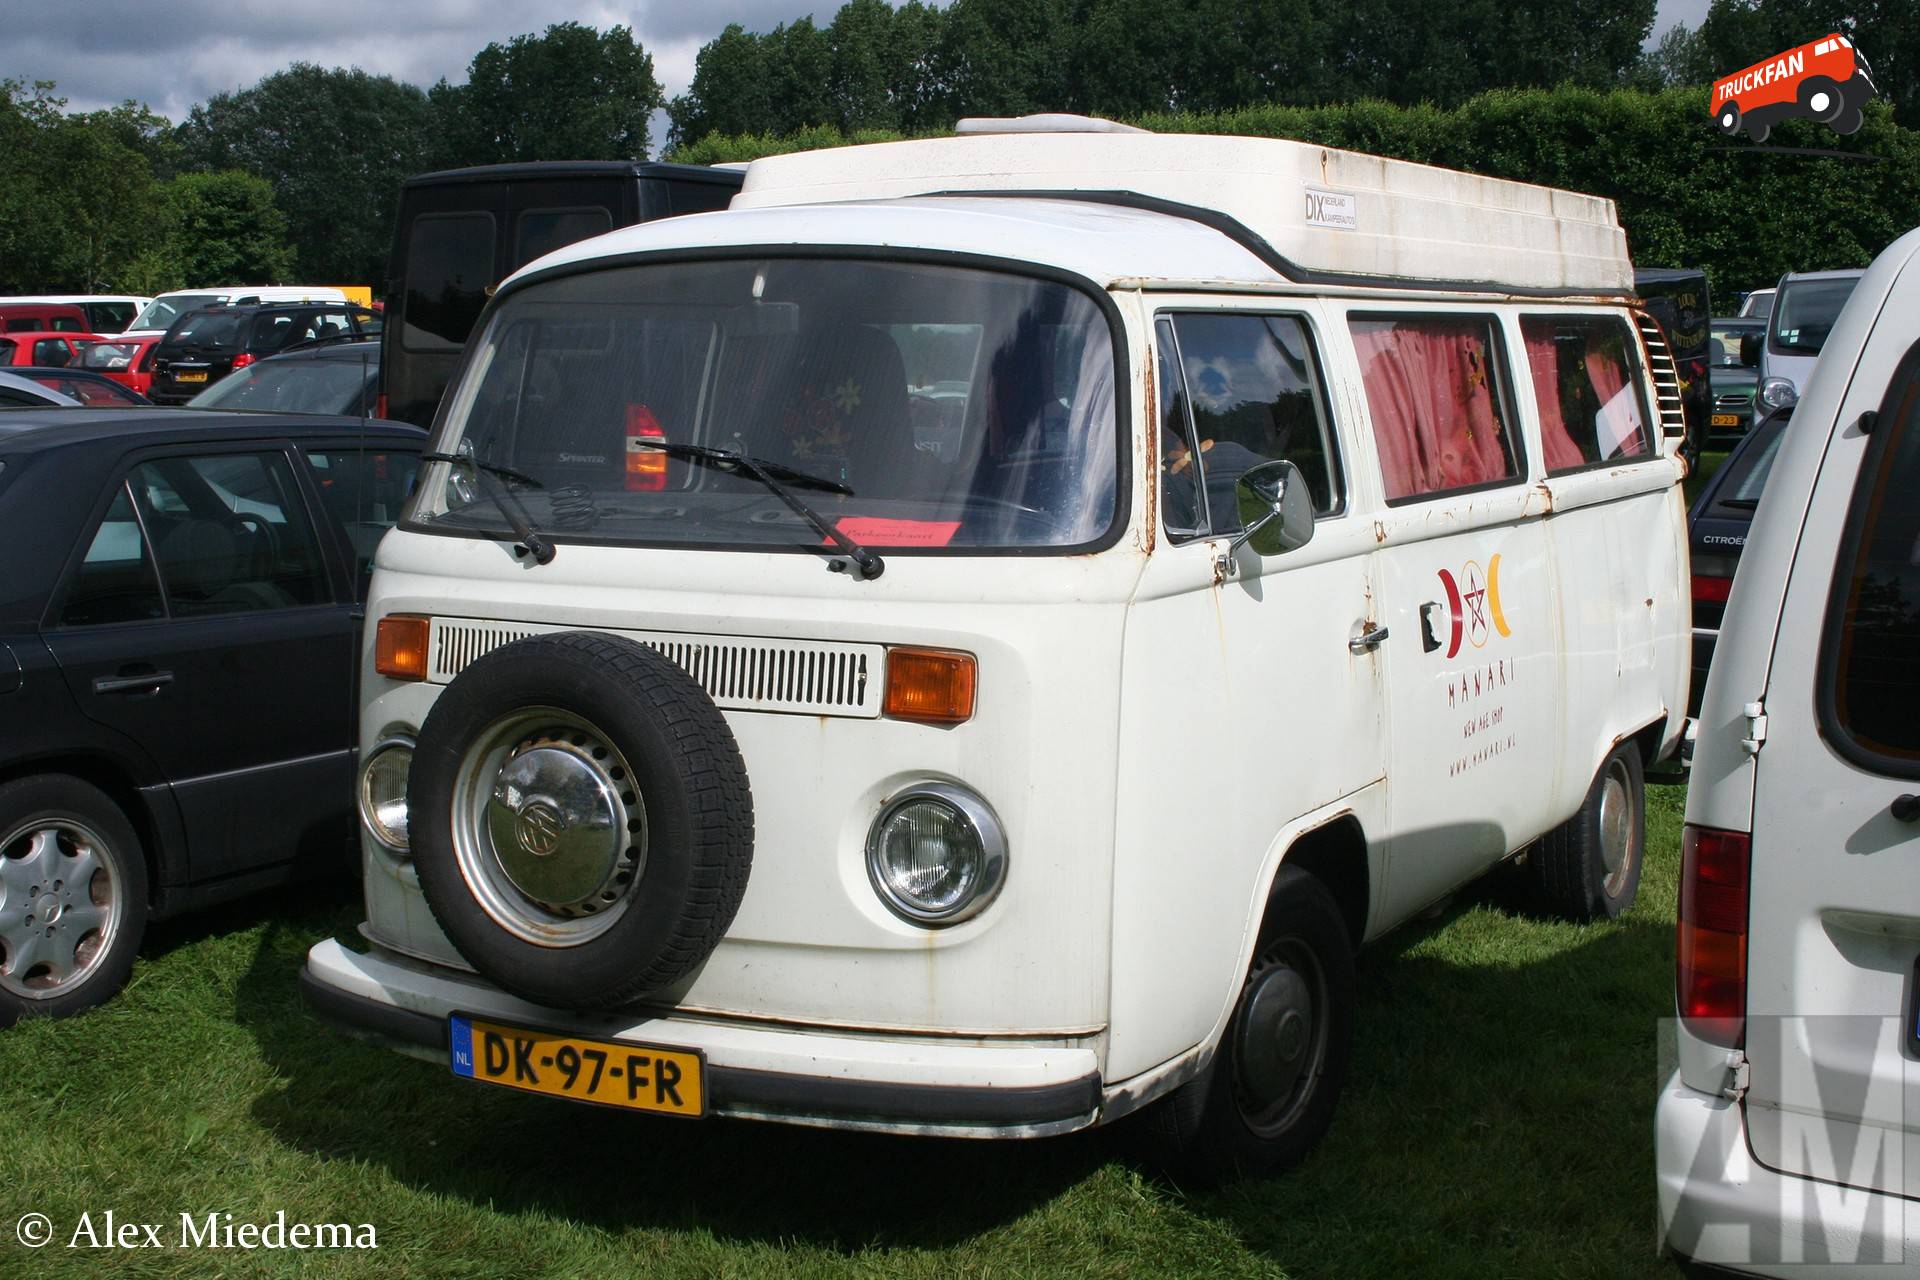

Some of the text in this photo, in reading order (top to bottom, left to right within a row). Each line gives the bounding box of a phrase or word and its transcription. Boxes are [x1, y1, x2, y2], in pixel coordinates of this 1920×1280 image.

[1305, 194, 1325, 221] DIX
[1713, 416, 1735, 425] D-23
[1448, 657, 1515, 709] MANARI
[456, 1051, 471, 1066] NL
[484, 1031, 684, 1107] DK-97-FR
